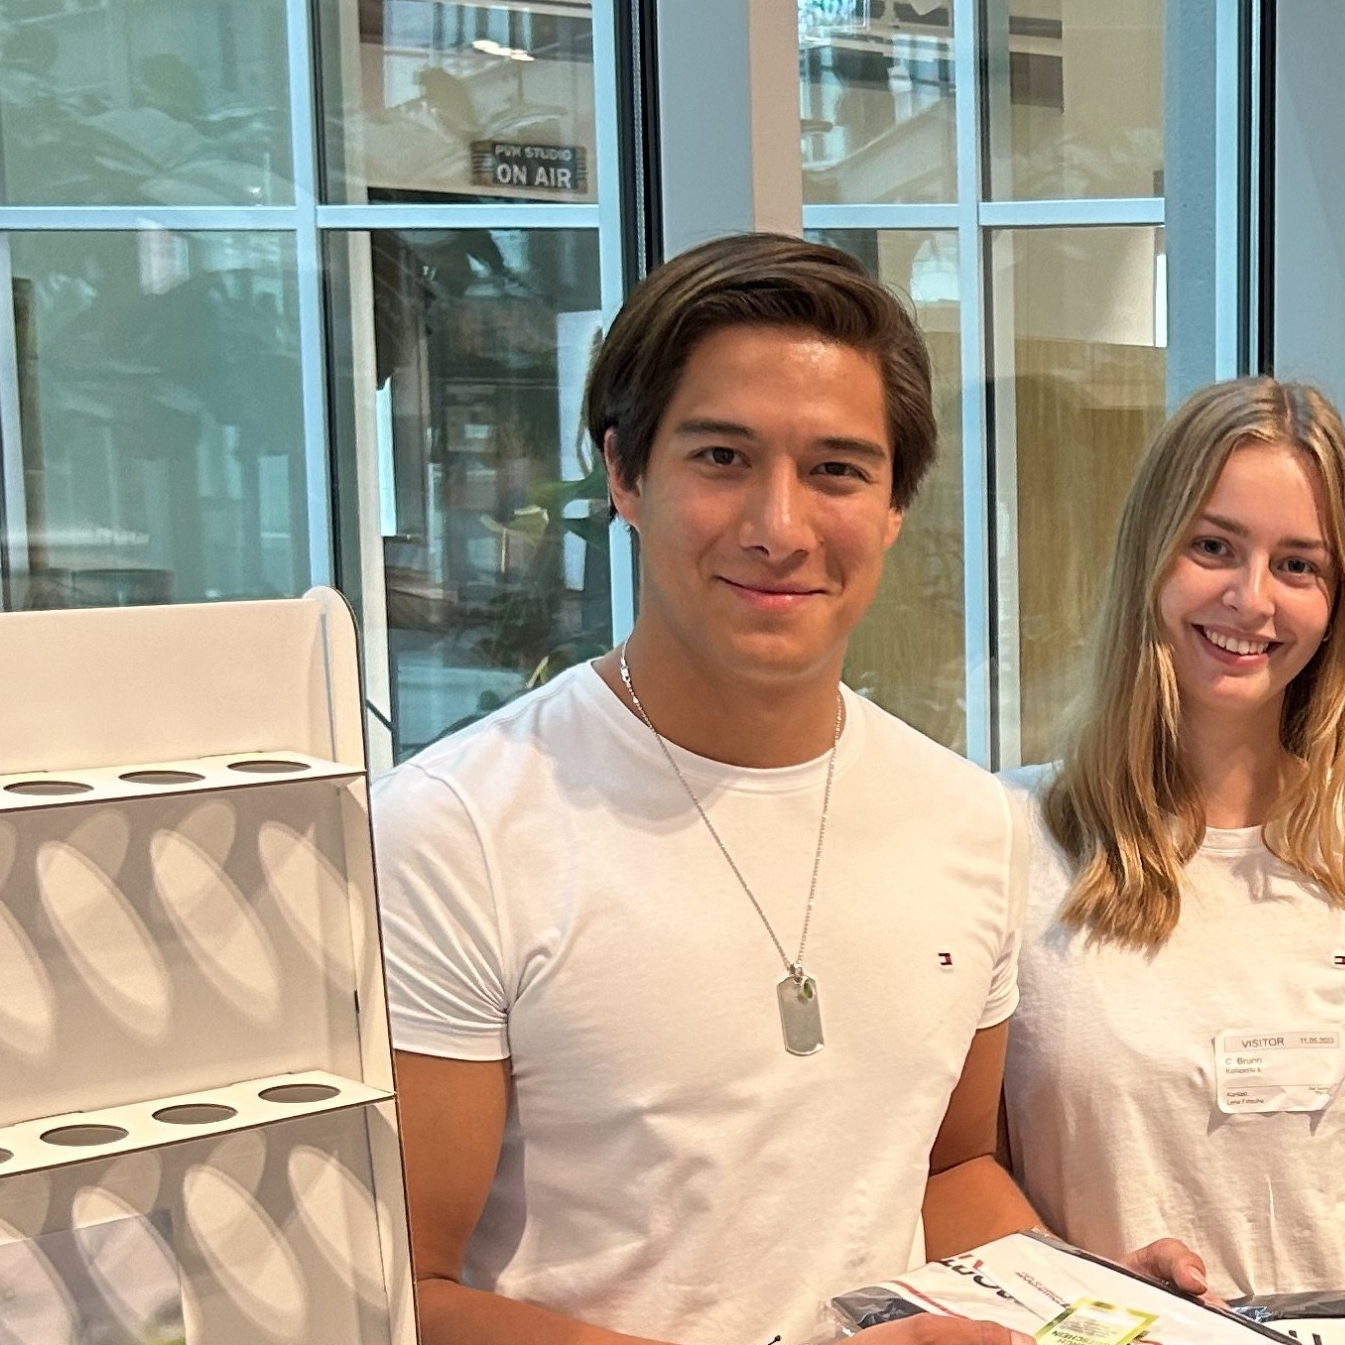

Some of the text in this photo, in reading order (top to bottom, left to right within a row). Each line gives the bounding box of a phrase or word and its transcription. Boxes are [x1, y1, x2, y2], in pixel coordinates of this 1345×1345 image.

[524, 146, 573, 161] STUDIO
[496, 163, 572, 189] ON AIR
[1241, 1037, 1285, 1049] VISITOR
